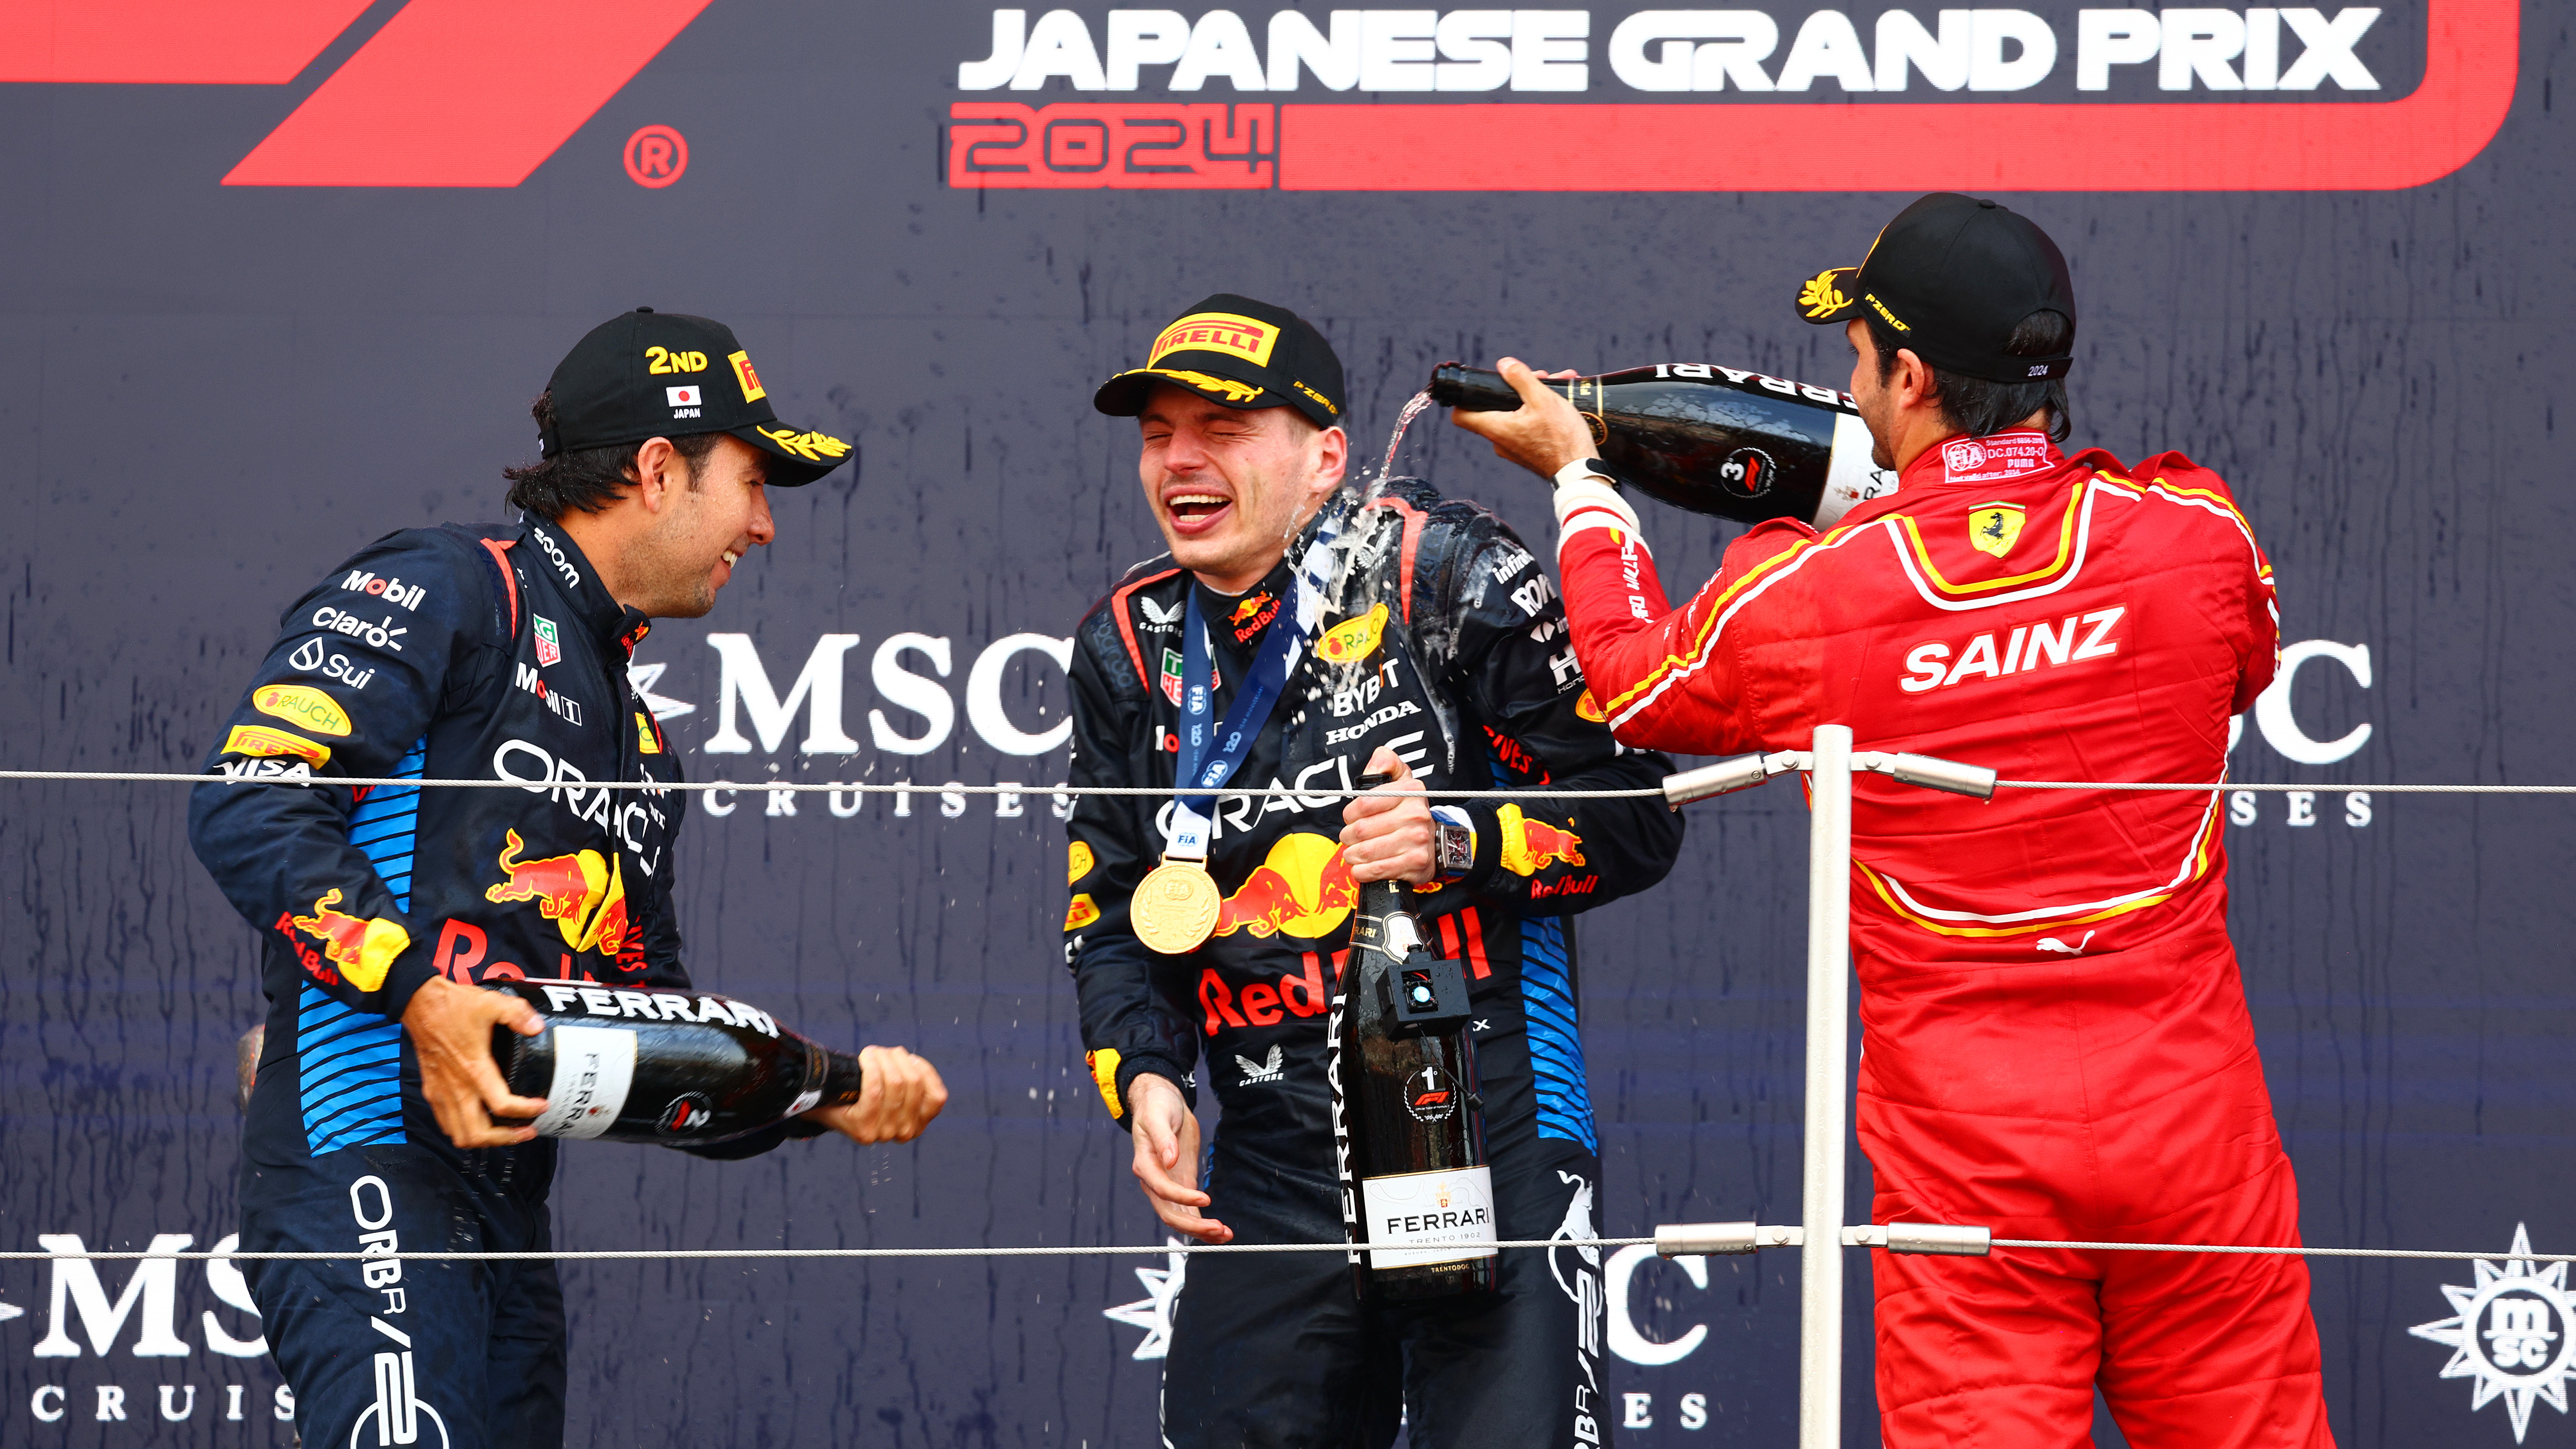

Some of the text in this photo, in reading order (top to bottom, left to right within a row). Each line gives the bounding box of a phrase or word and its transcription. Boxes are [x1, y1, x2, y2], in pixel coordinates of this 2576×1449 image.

[958, 8, 2384, 92] JAPANESE GRAND PRIX
[951, 105, 1274, 181] 2024
[1152, 319, 1264, 360] PIRELLI
[645, 346, 708, 375] 2ND
[2027, 365, 2049, 377] 2024
[673, 408, 701, 419] JAPAN
[1949, 447, 1983, 467] FIA
[1986, 438, 2016, 446] Standard
[534, 527, 580, 589] zoom
[341, 569, 426, 611] Mobil
[312, 606, 391, 648] Claro
[1900, 606, 2126, 694] SAINZ
[322, 654, 375, 689] Sui
[1333, 657, 1399, 718] BYBIT
[704, 631, 1075, 756] MSC
[1191, 686, 1204, 712] FIA
[277, 695, 341, 731] RAUCH
[1326, 700, 1422, 745] HONDA
[213, 756, 310, 787] VISA
[1202, 764, 1227, 786] FIA
[1177, 833, 1196, 846] FIA
[1562, 874, 1599, 896] Bull
[1198, 950, 1328, 1037] Red
[541, 985, 781, 1040] FERRARI
[1239, 1073, 1285, 1087] CASTORE
[1327, 992, 1361, 1265] FERRARI
[1386, 1207, 1490, 1235] FERRARI
[1460, 1231, 1481, 1240] 1902
[1430, 1264, 1470, 1273] TRENTODOC
